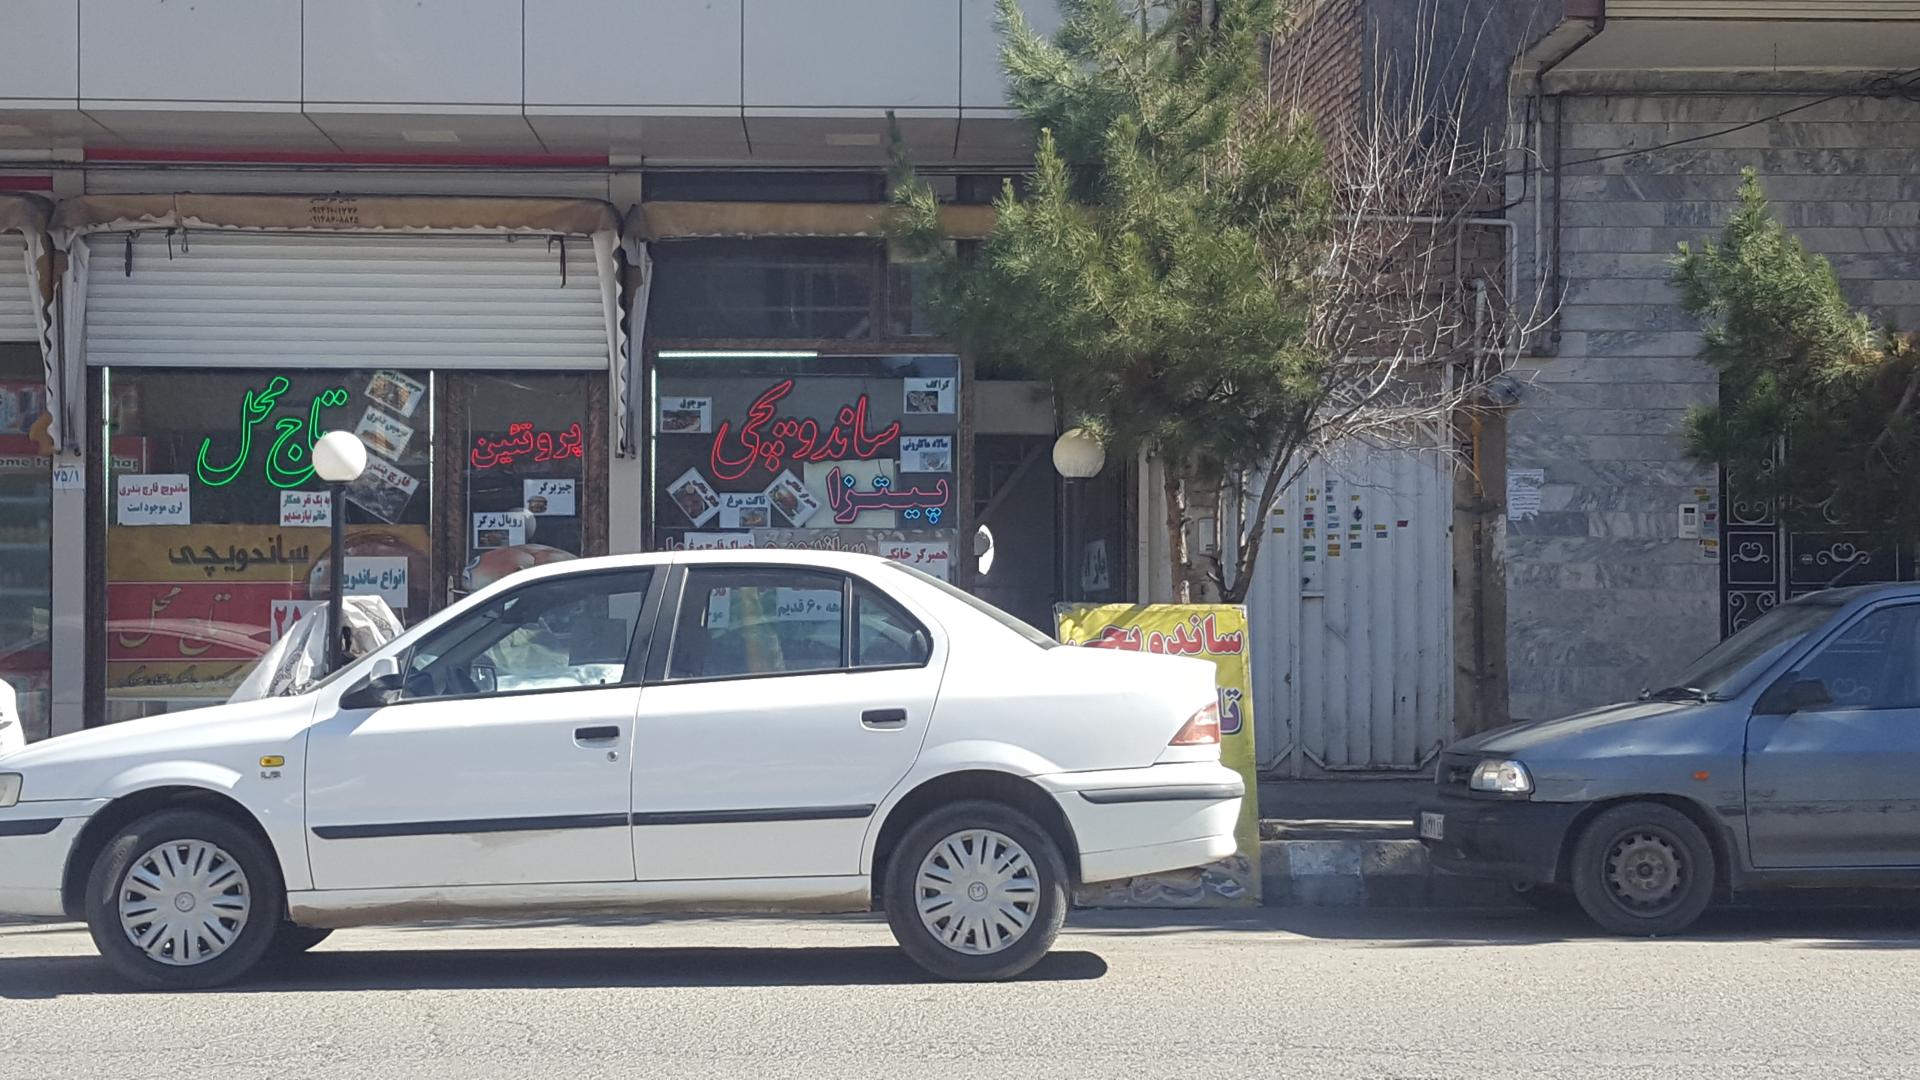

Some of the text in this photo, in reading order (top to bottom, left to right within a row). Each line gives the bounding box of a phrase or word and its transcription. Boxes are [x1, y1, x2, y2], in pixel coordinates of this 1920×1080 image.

[197, 375, 348, 488] تاج محل
[711, 379, 899, 480] ساندویچی
[119, 482, 188, 496] ساندویچ قارچ بندری
[827, 466, 950, 525] پیتزا
[127, 501, 143, 512] است
[144, 503, 167, 515] موجود
[726, 495, 743, 508] مرغ
[169, 534, 309, 576] ساندویچی
[380, 568, 406, 590] انواع
